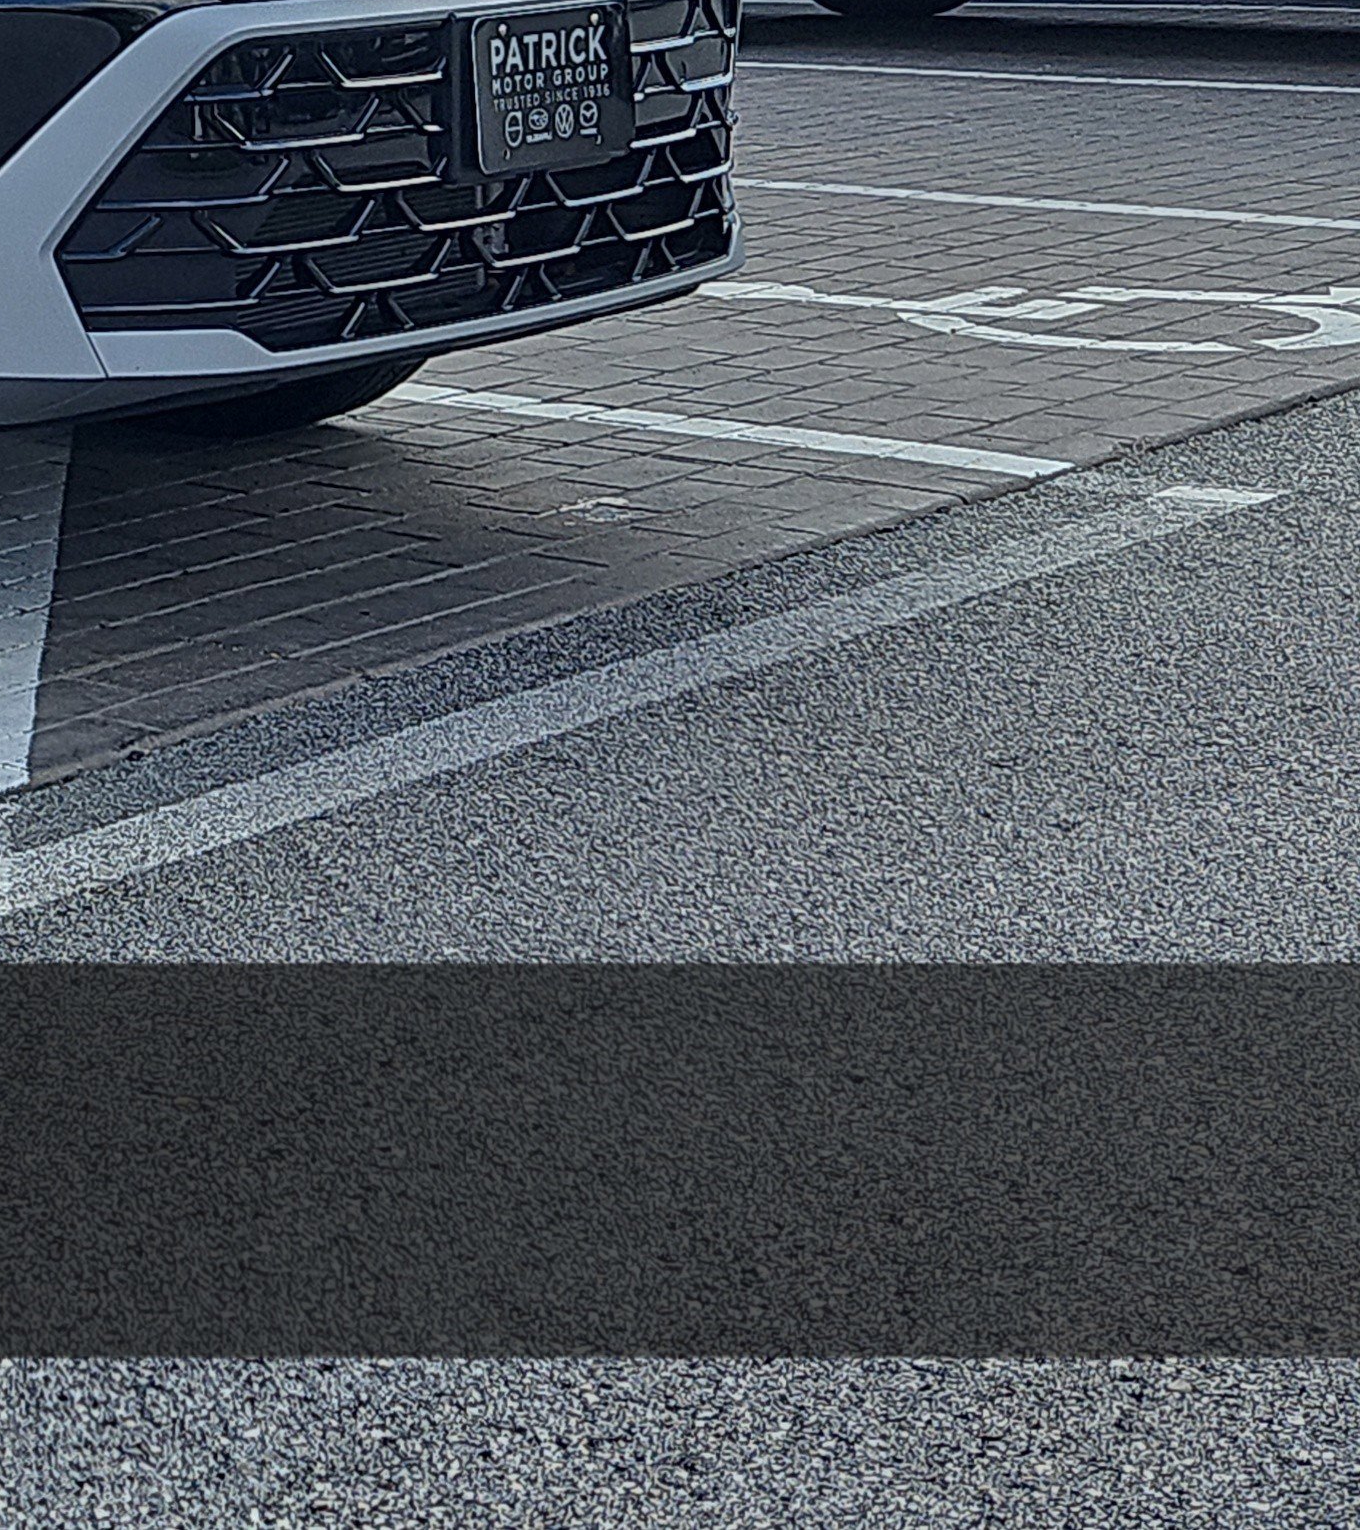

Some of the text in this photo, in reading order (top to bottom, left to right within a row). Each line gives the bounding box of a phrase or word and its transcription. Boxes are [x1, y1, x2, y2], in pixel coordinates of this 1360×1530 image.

[490, 24, 608, 76] PATRICK
[492, 63, 609, 97] MOTOR GROUP
[493, 92, 541, 112] TRUSTED
[545, 86, 579, 104] SINCE
